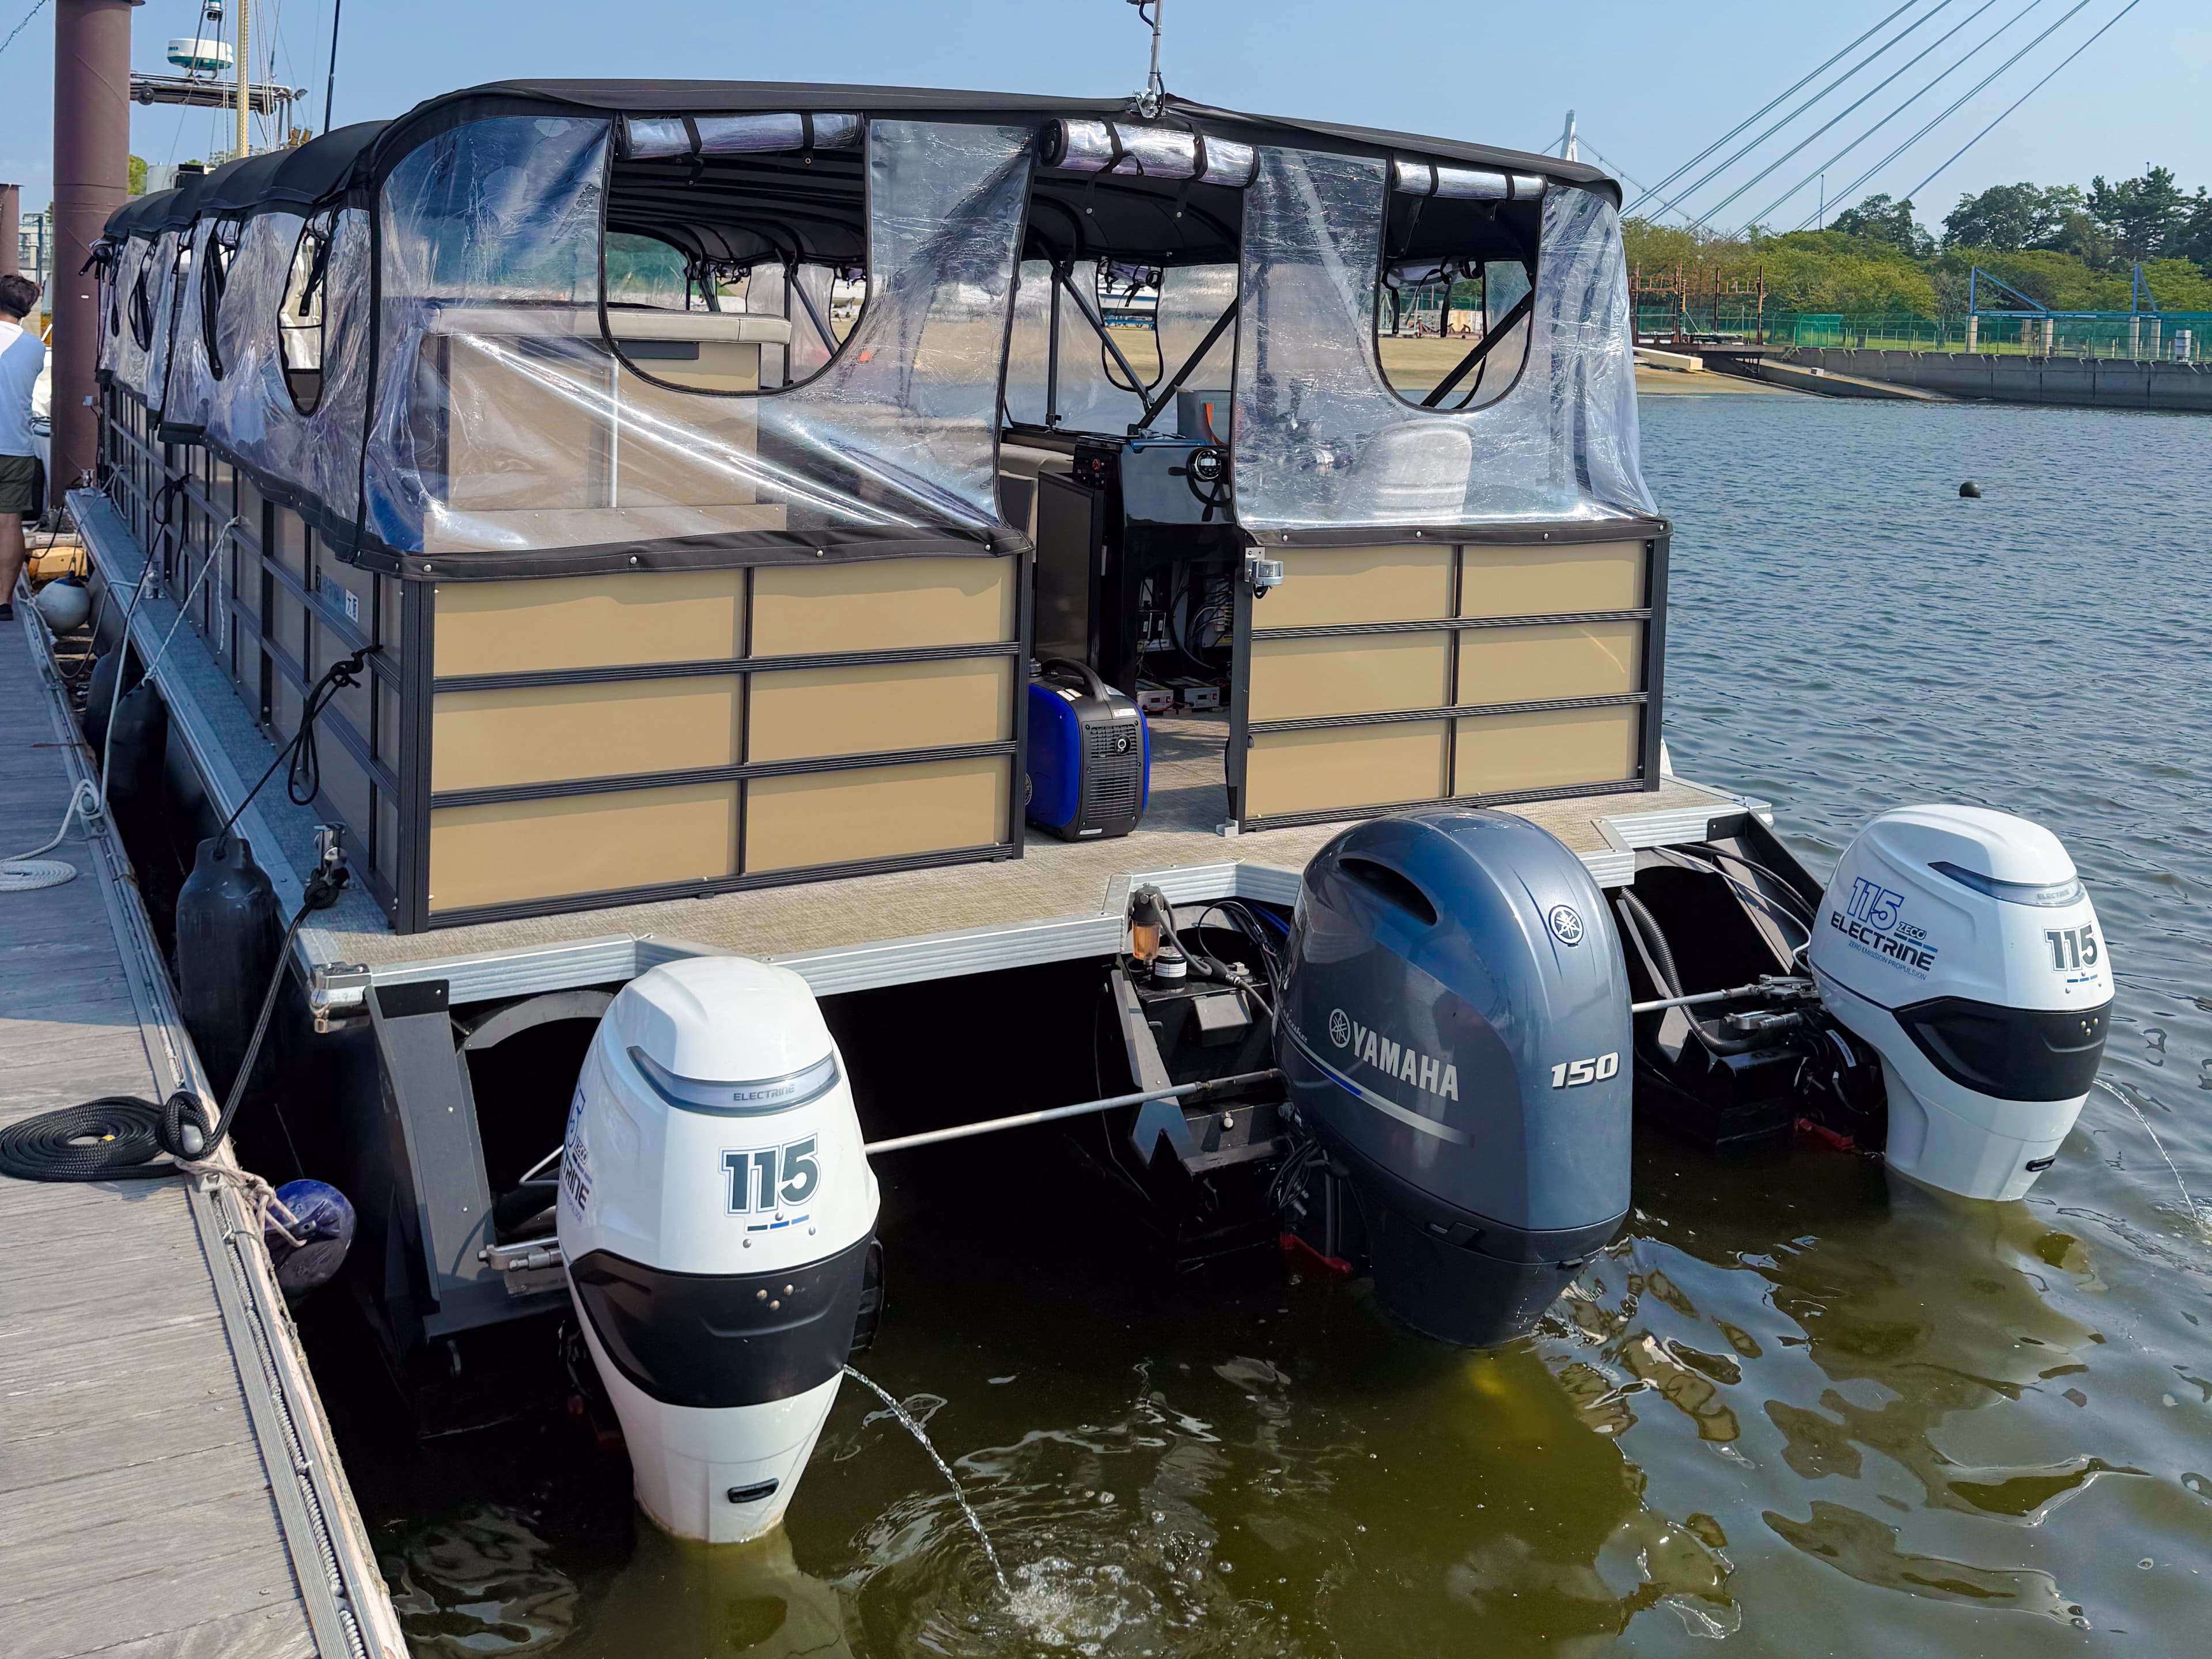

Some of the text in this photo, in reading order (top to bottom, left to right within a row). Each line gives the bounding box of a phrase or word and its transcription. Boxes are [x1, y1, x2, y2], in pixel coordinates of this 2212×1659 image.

[1847, 876, 1905, 930] 115
[1831, 911, 1935, 971] ELECTRINE
[1849, 940, 1861, 951] ZERO
[1888, 959, 1927, 980] PROPULSION
[2044, 921, 2097, 971] 115
[1353, 1021, 1459, 1101] YAMAHA
[1551, 1051, 1619, 1088] 150
[733, 1084, 795, 1101] ELECTRINE
[721, 1132, 821, 1214] 115
